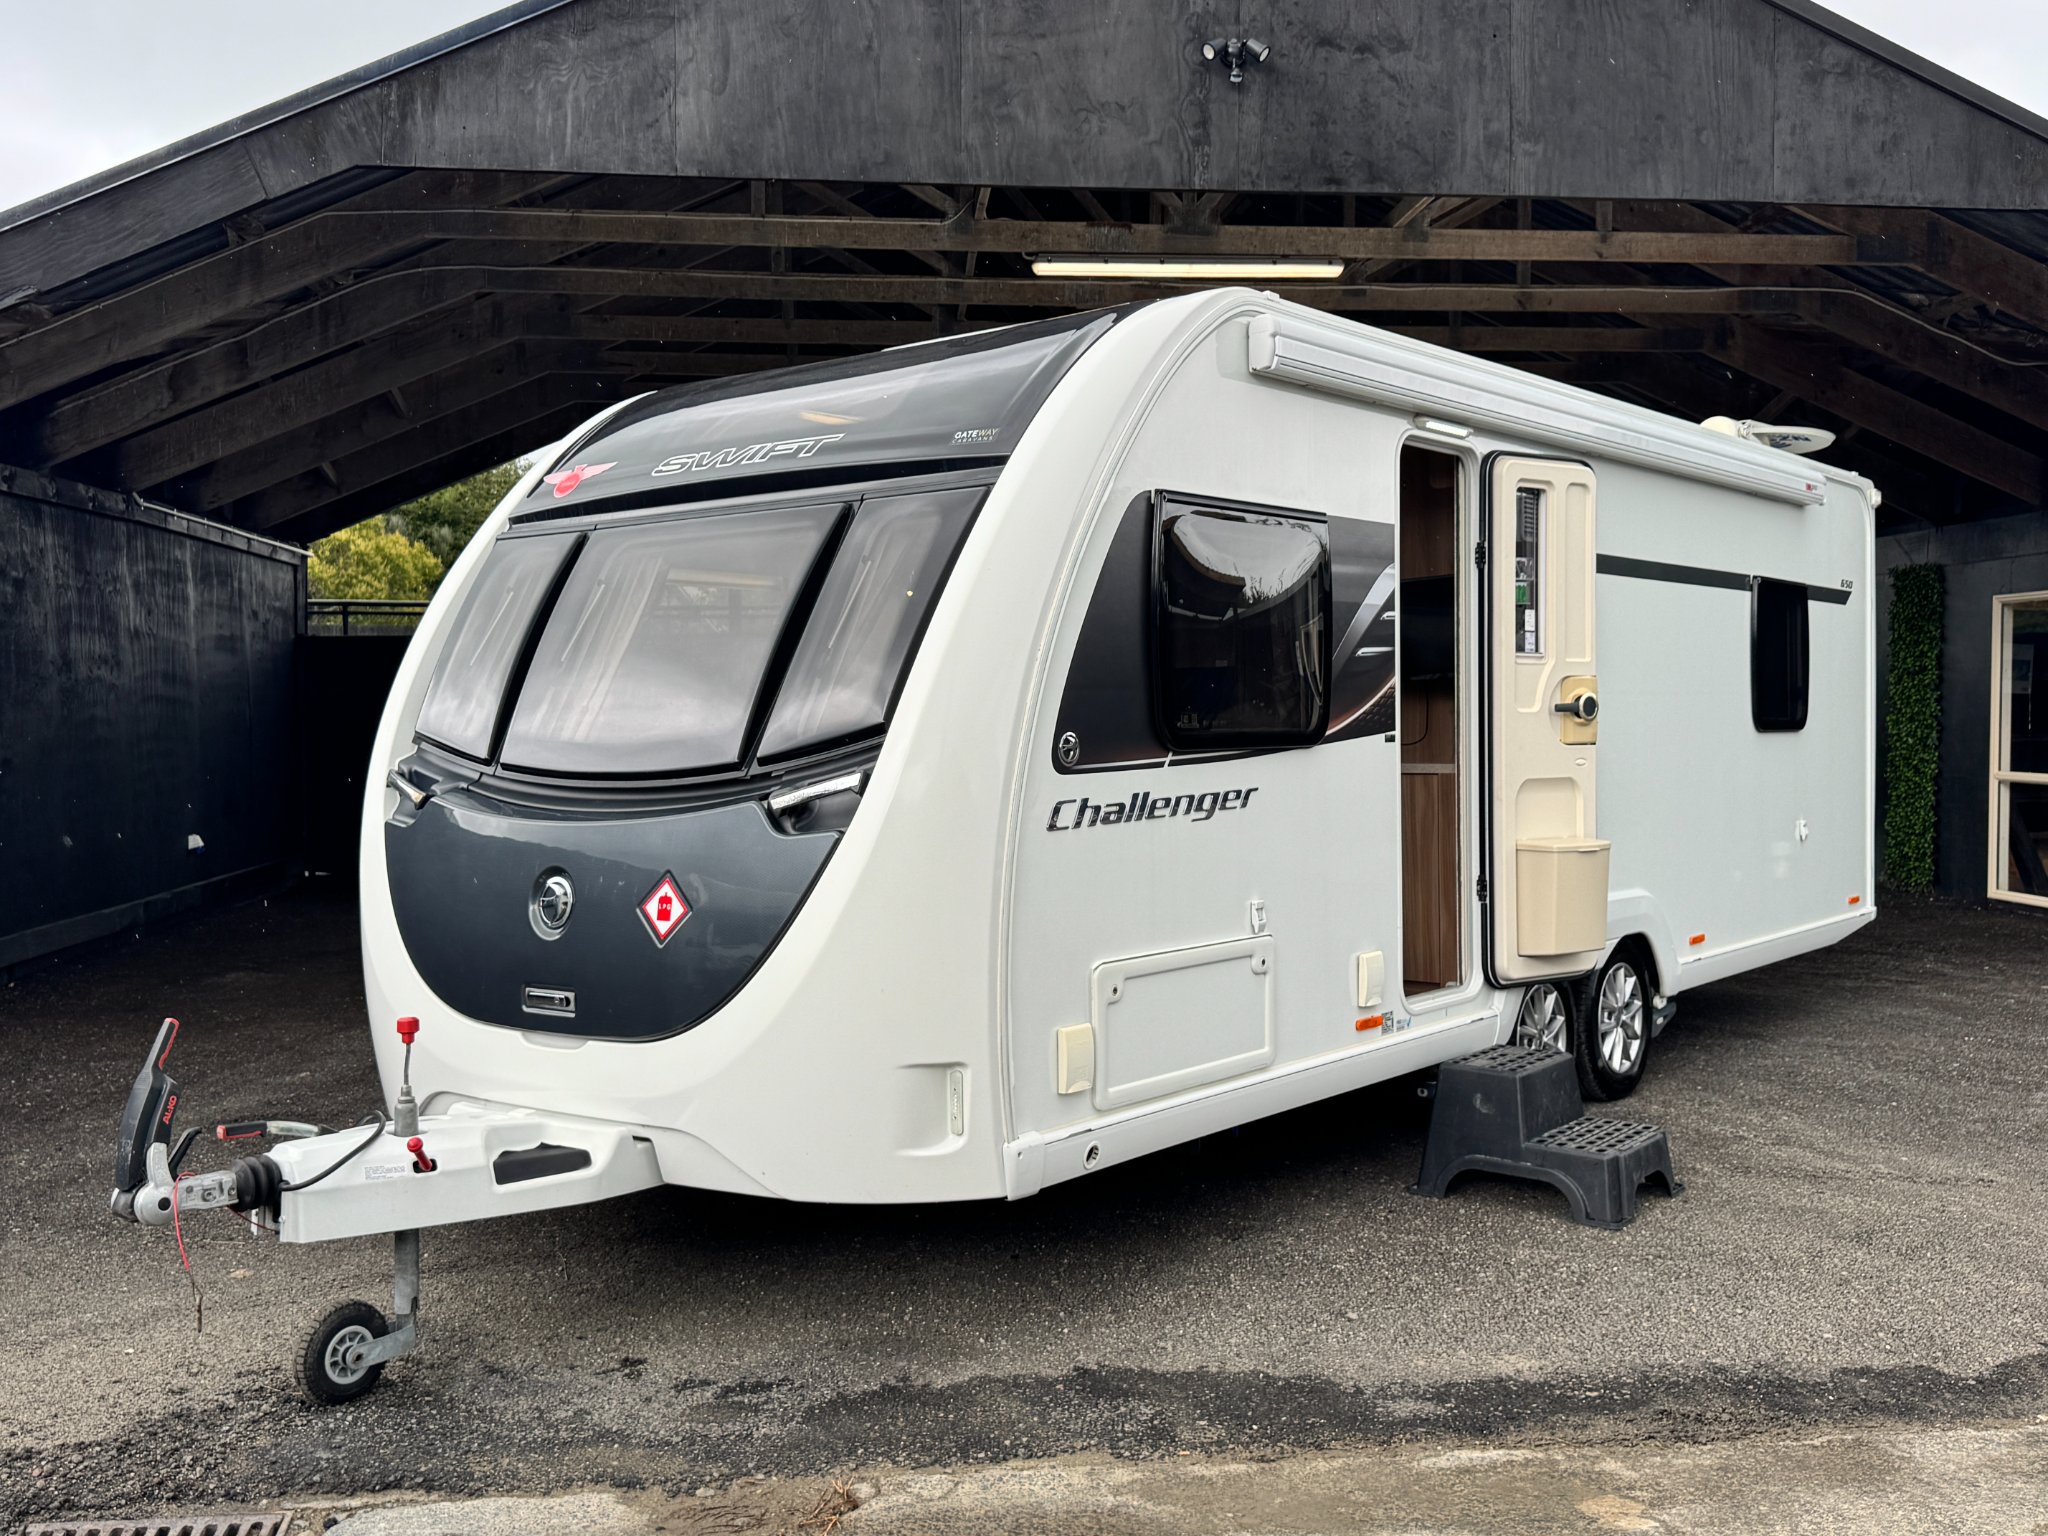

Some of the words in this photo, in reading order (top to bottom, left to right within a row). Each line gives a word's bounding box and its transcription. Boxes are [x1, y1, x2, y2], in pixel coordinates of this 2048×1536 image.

[954, 427, 999, 439] GATEWAY
[651, 432, 847, 477] SWIFT
[1840, 579, 1854, 590] 650
[1046, 787, 1259, 832] Challenger
[658, 903, 672, 911] LPG
